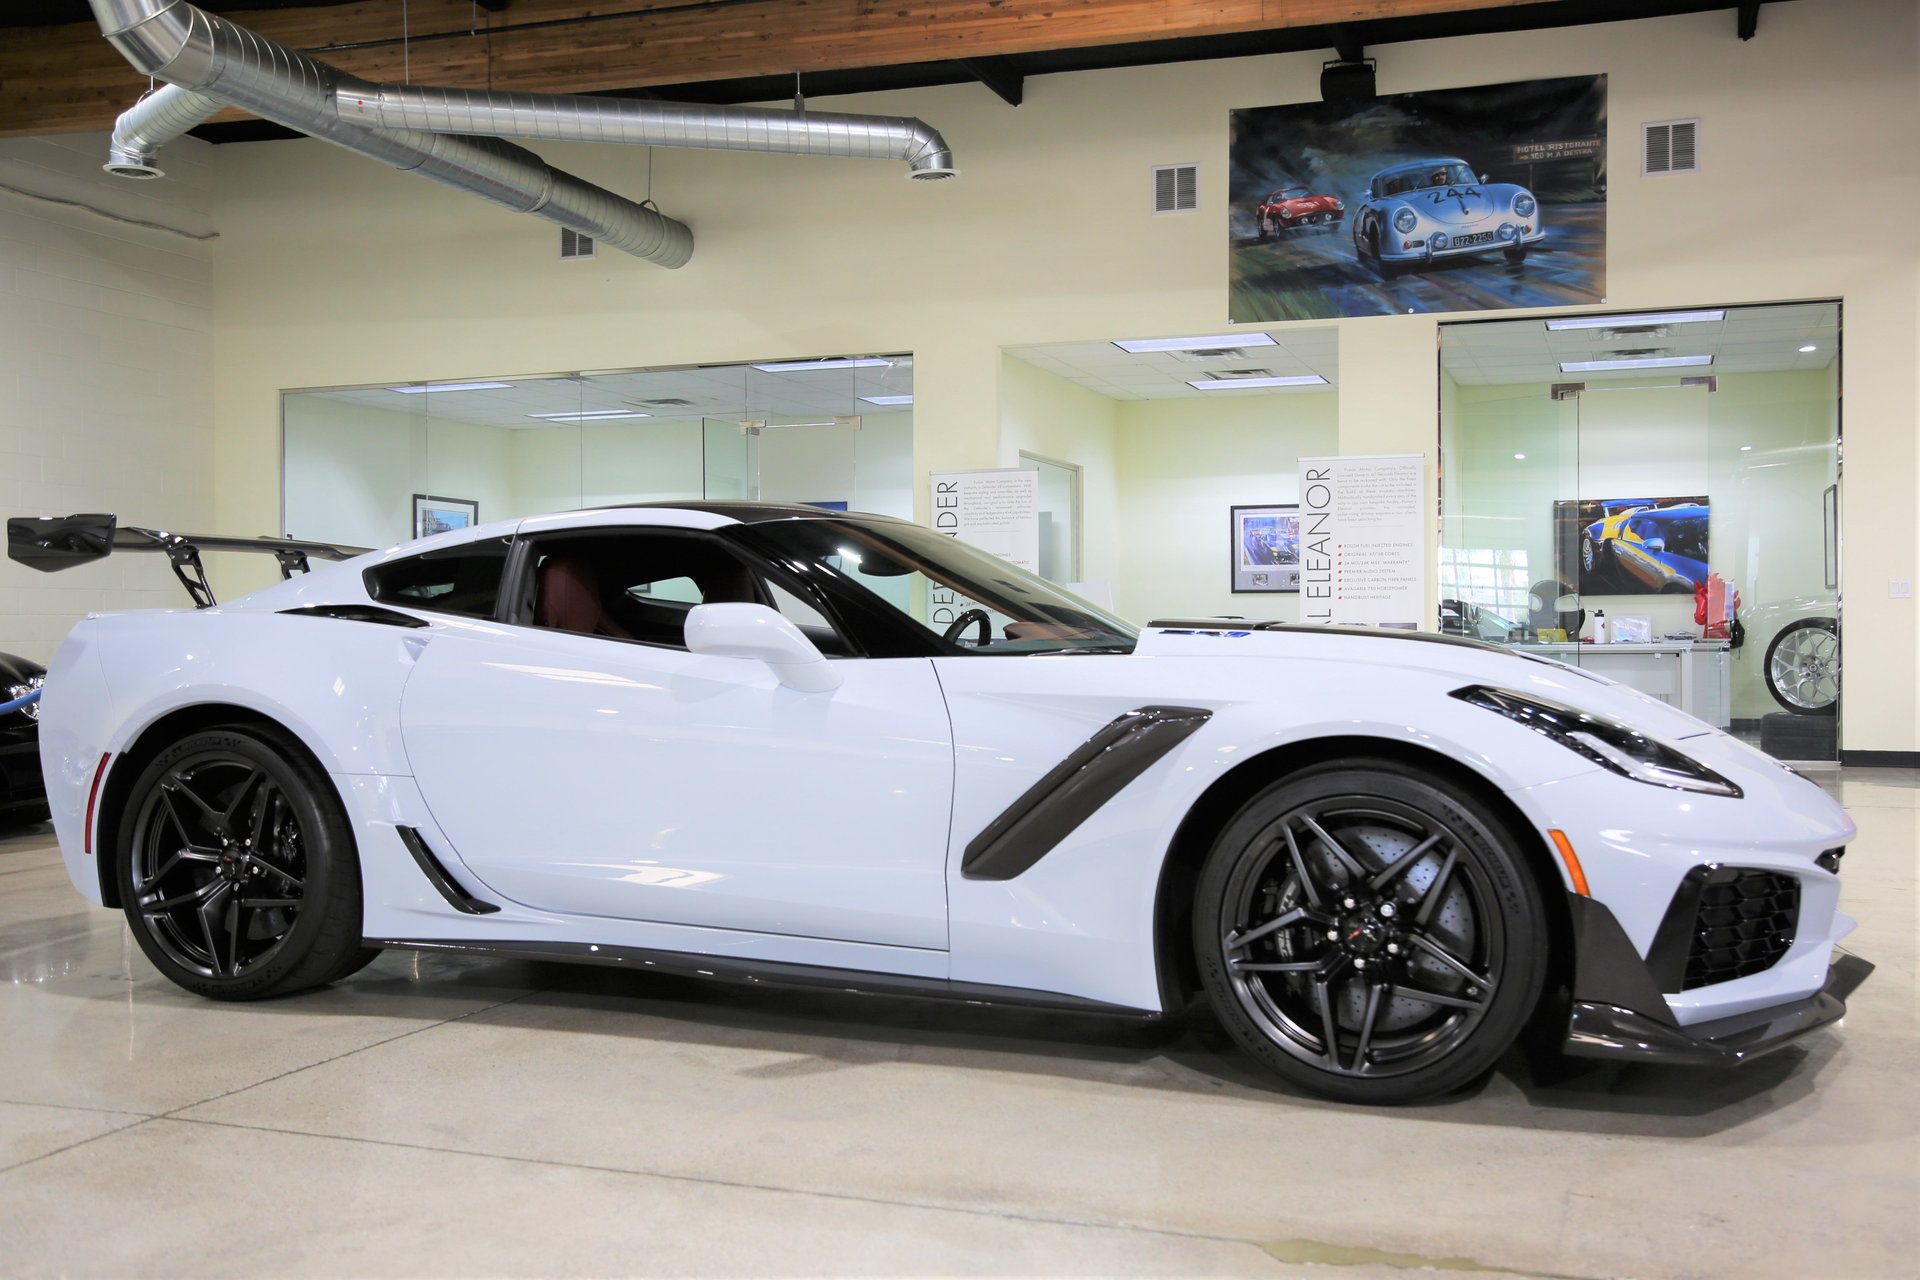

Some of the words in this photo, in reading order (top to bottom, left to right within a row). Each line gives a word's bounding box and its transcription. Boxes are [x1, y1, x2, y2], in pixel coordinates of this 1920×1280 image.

[1516, 144, 1546, 153] HOTEL
[1563, 148, 1592, 156] DESTRA
[1427, 186, 1481, 204] 244
[1306, 468, 1331, 598] ELEANOR
